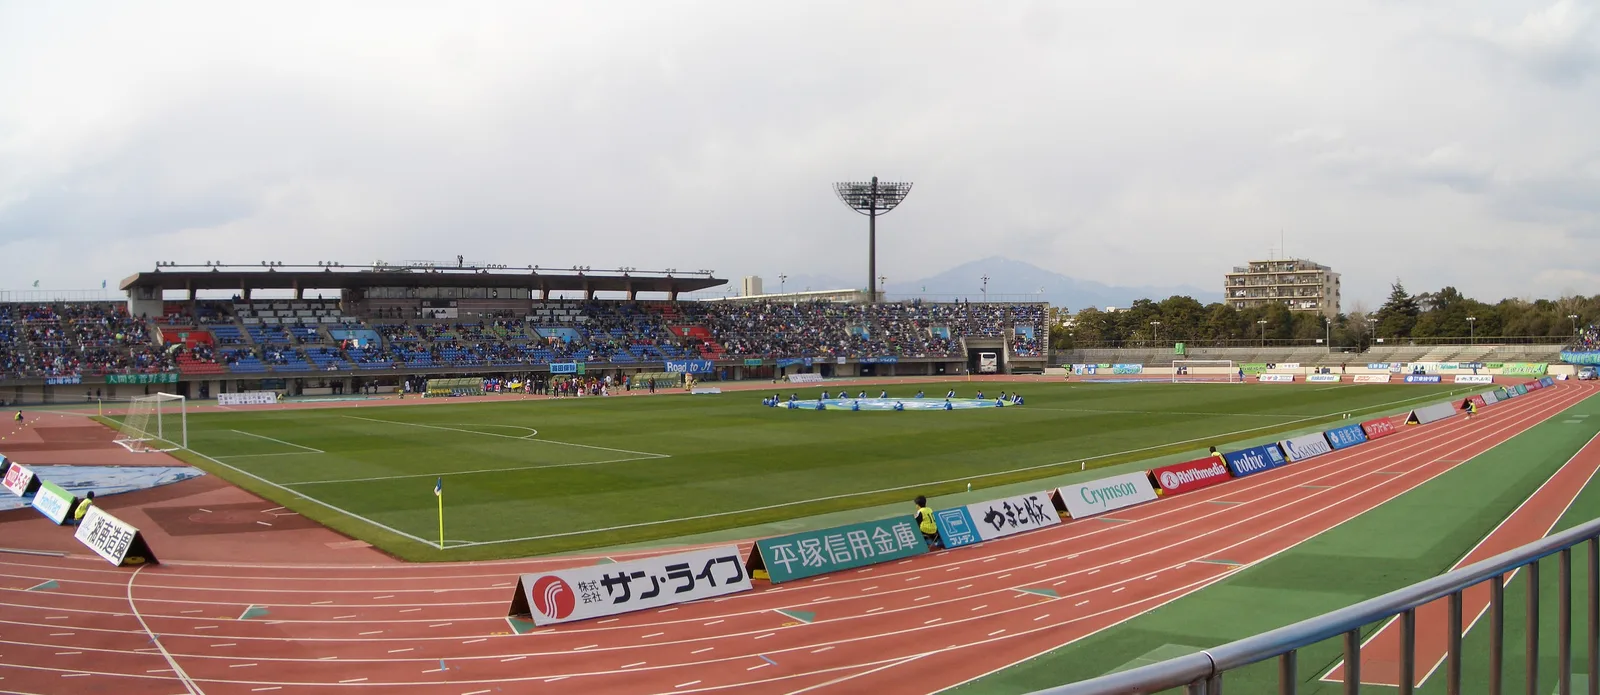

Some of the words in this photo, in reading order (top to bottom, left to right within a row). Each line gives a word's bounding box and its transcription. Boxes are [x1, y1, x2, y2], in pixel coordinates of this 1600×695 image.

[667, 361, 687, 373] Road
[690, 361, 698, 372] to
[1299, 440, 1327, 459] SANKYO
[1234, 450, 1267, 473] volvic
[1080, 480, 1138, 508] Crymson
[769, 521, 919, 574] 平塚信用金庫
[949, 534, 975, 546] フリーデン
[578, 580, 599, 593] 株式
[581, 591, 603, 604] 会社
